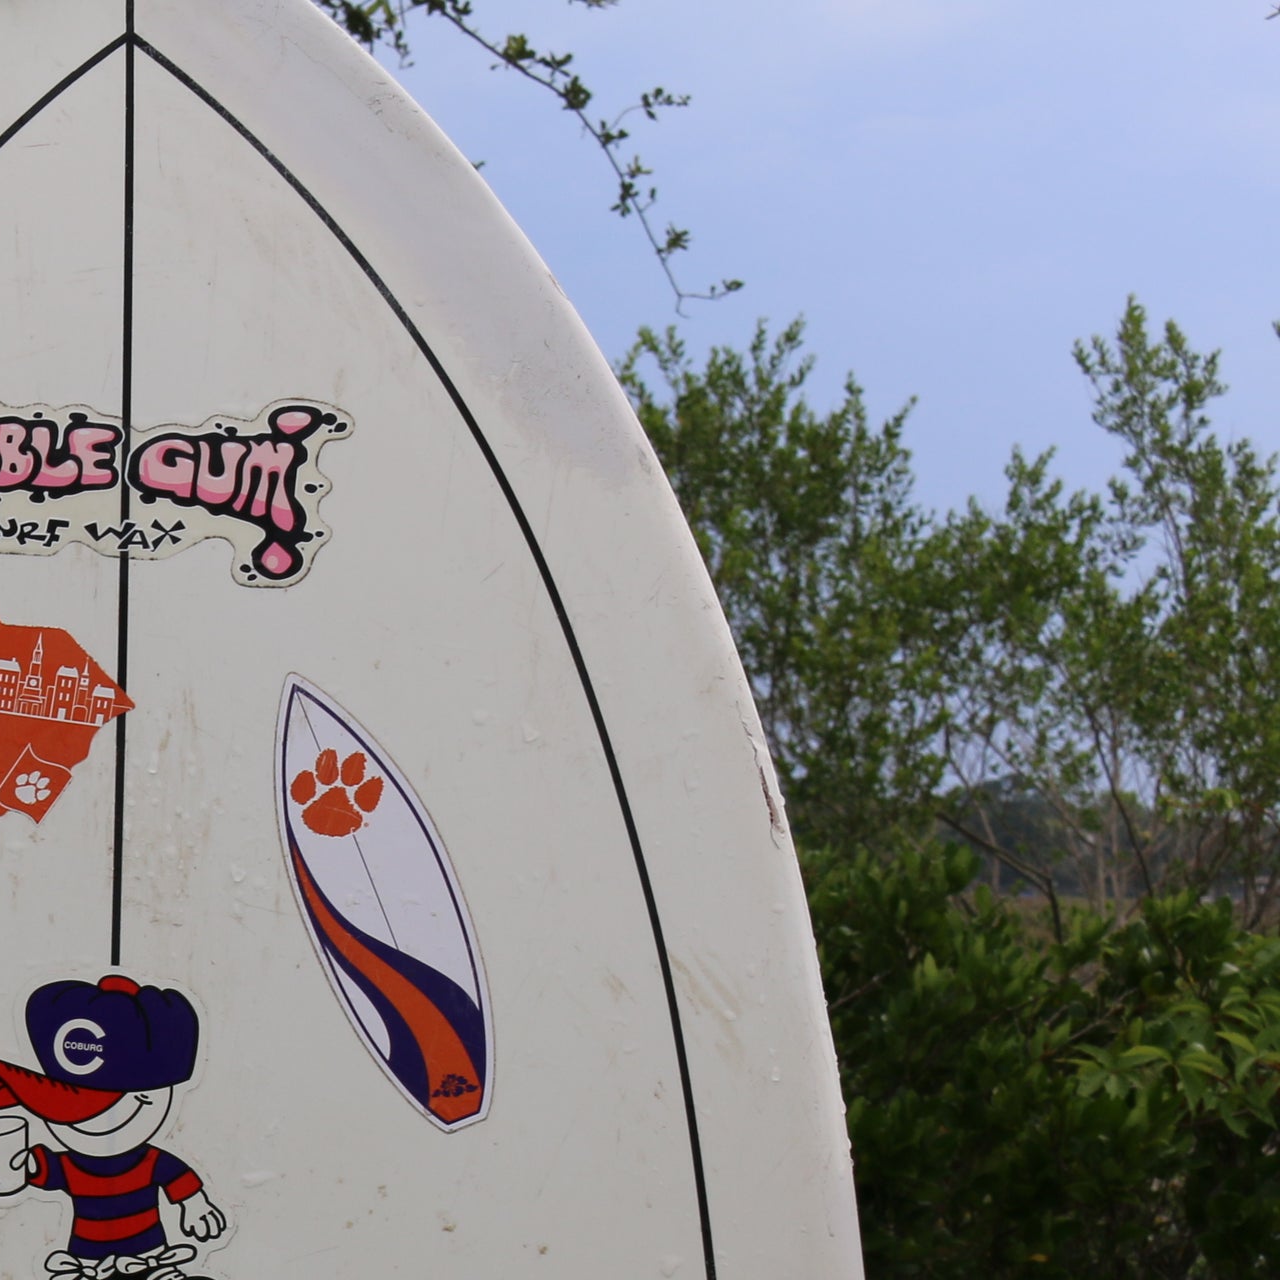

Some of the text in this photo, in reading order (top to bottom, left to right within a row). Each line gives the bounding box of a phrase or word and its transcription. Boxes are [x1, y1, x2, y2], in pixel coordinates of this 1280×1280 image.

[127, 406, 308, 580] GUM
[84, 517, 187, 551] WAX
[53, 1018, 106, 1075] C
[64, 1041, 103, 1052] COBURG
